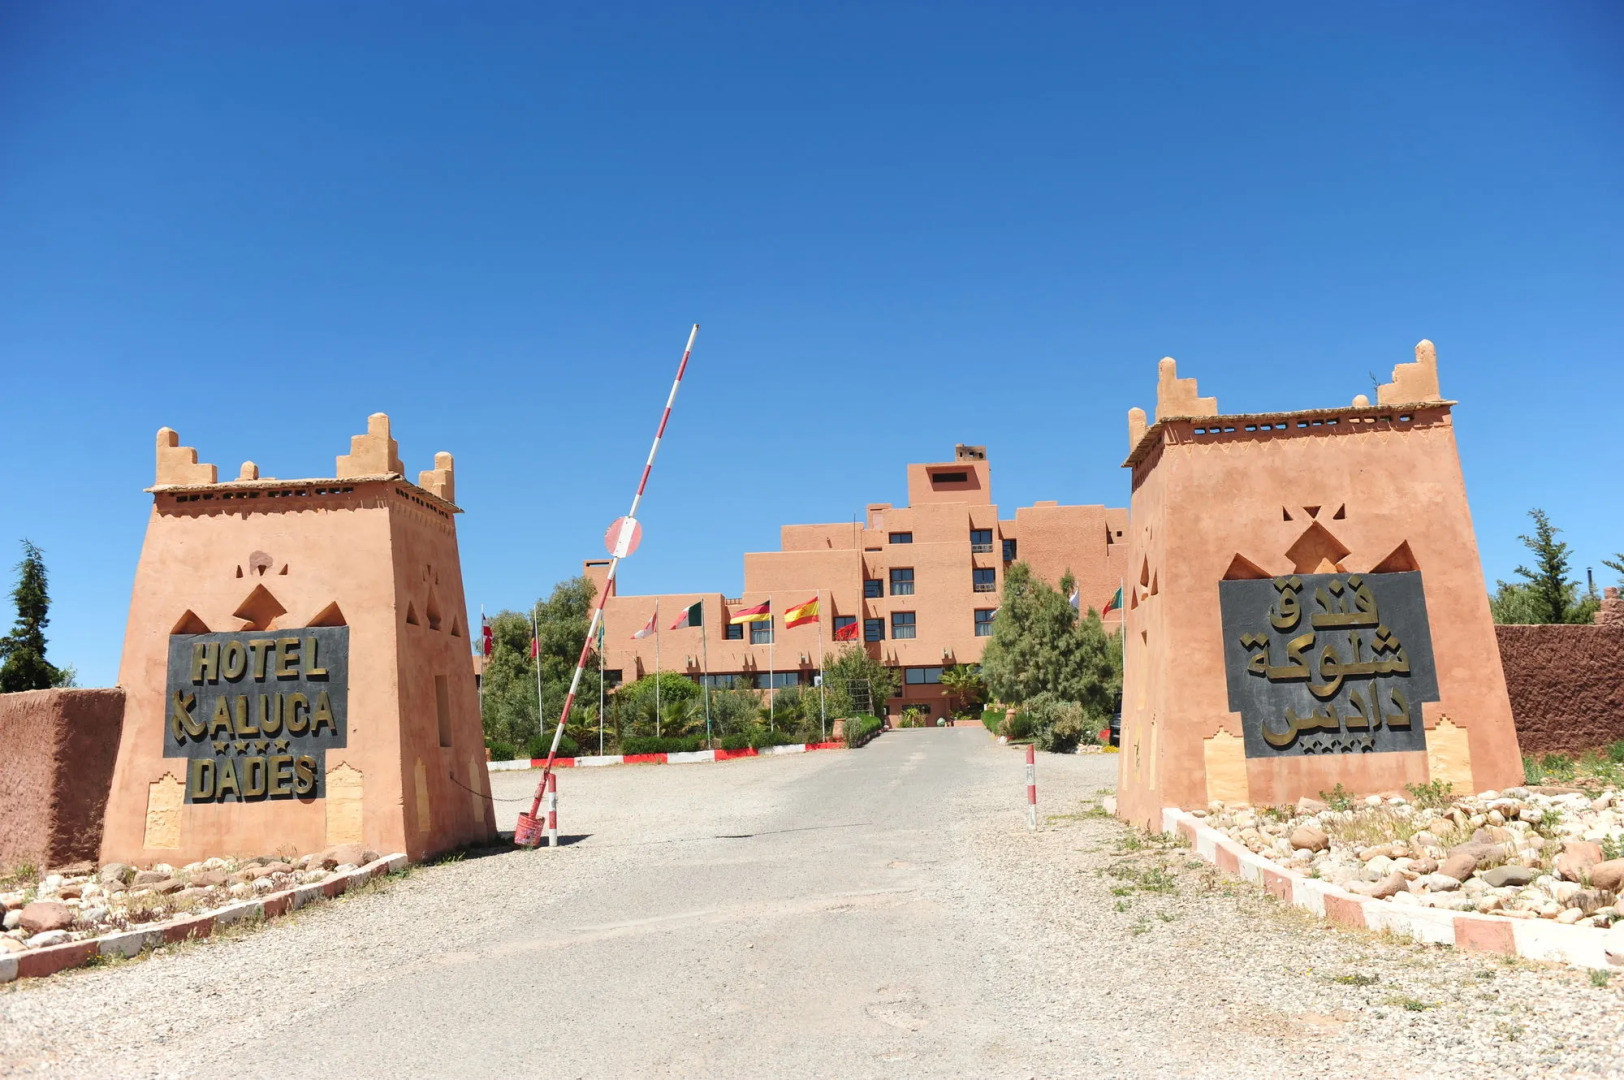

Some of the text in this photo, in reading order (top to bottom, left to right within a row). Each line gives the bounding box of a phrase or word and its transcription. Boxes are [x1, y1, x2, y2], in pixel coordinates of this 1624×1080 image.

[1269, 575, 1379, 630] فندق
[190, 637, 329, 684] HOTEL
[1261, 680, 1411, 746] دادس
[191, 754, 317, 801] DADES
